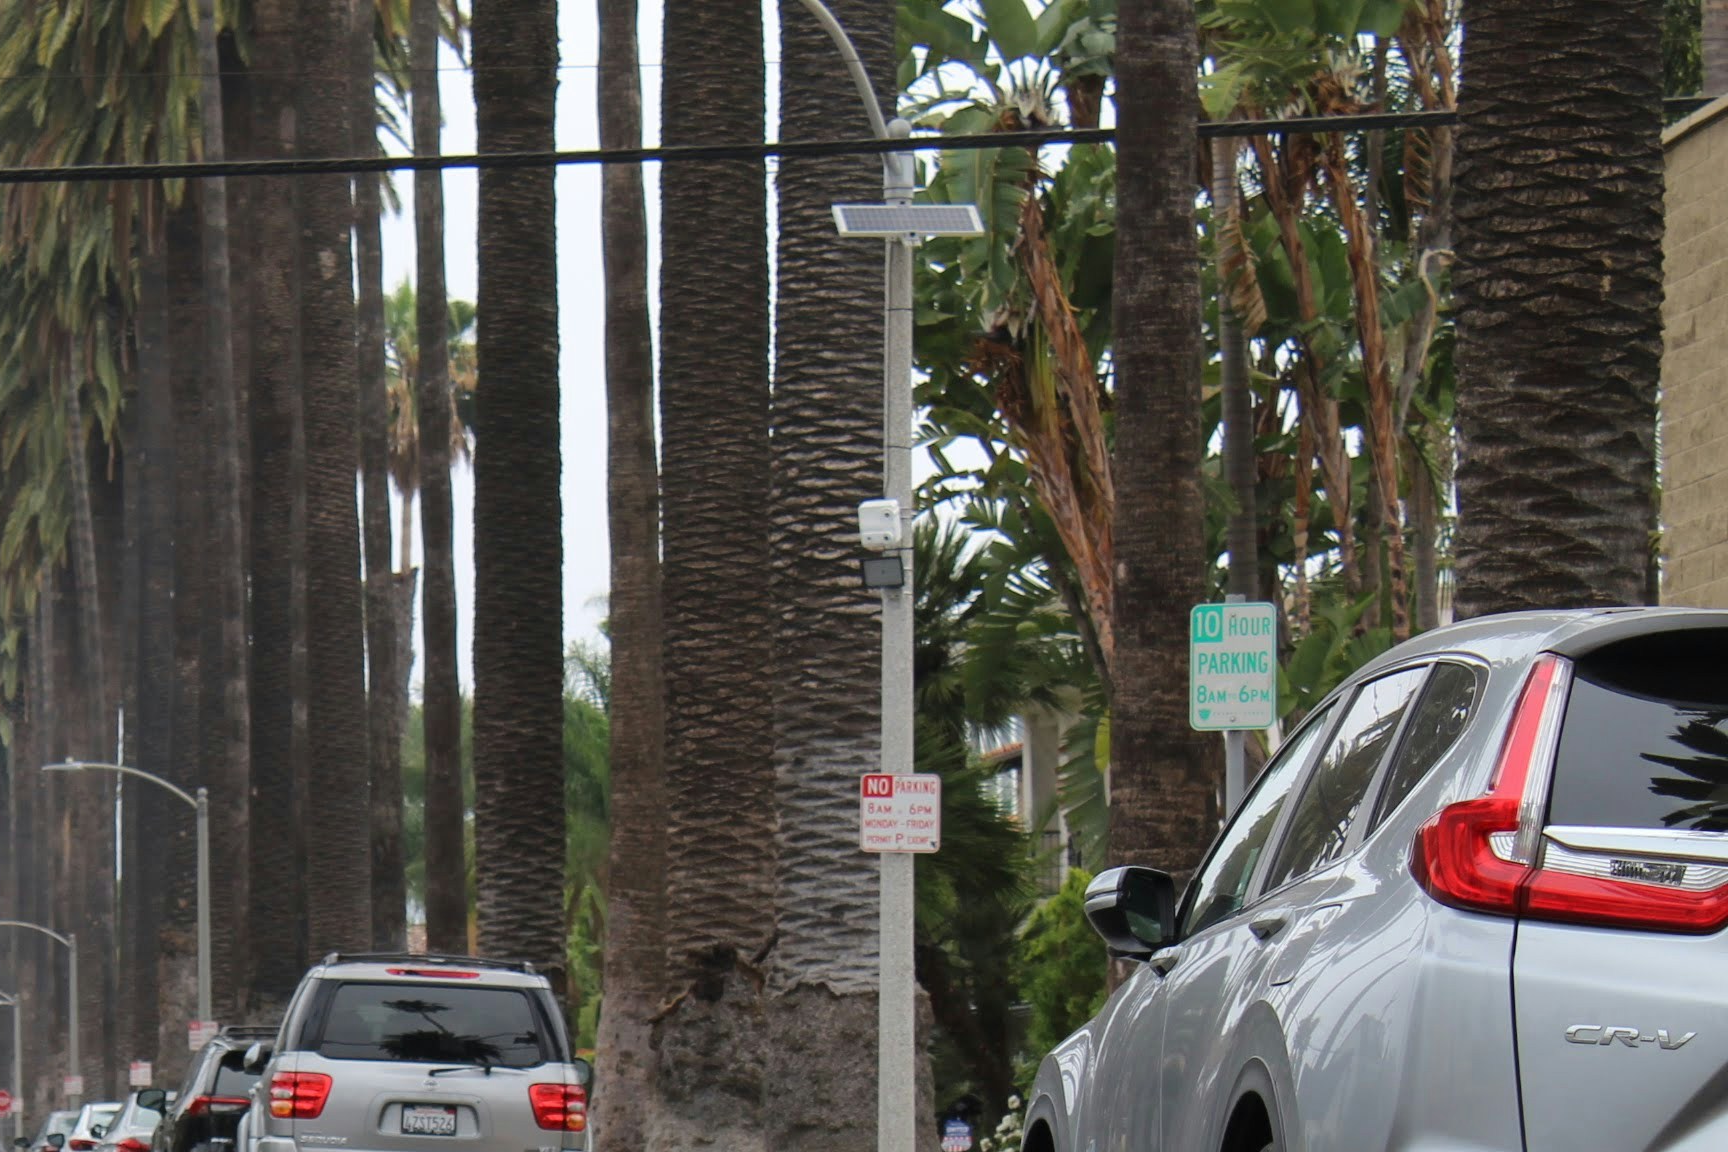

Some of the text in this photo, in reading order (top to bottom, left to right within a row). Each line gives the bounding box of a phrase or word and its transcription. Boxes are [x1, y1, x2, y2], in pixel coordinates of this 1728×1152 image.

[1195, 610, 1271, 638] 10 HOUR
[1198, 651, 1269, 674] PARKING
[1196, 685, 1227, 703] 8AM
[1238, 685, 1270, 703] 6PM
[867, 778, 936, 795] NO PARKING
[906, 820, 935, 829] FRIDAY
[1564, 1024, 1698, 1050] CR-V
